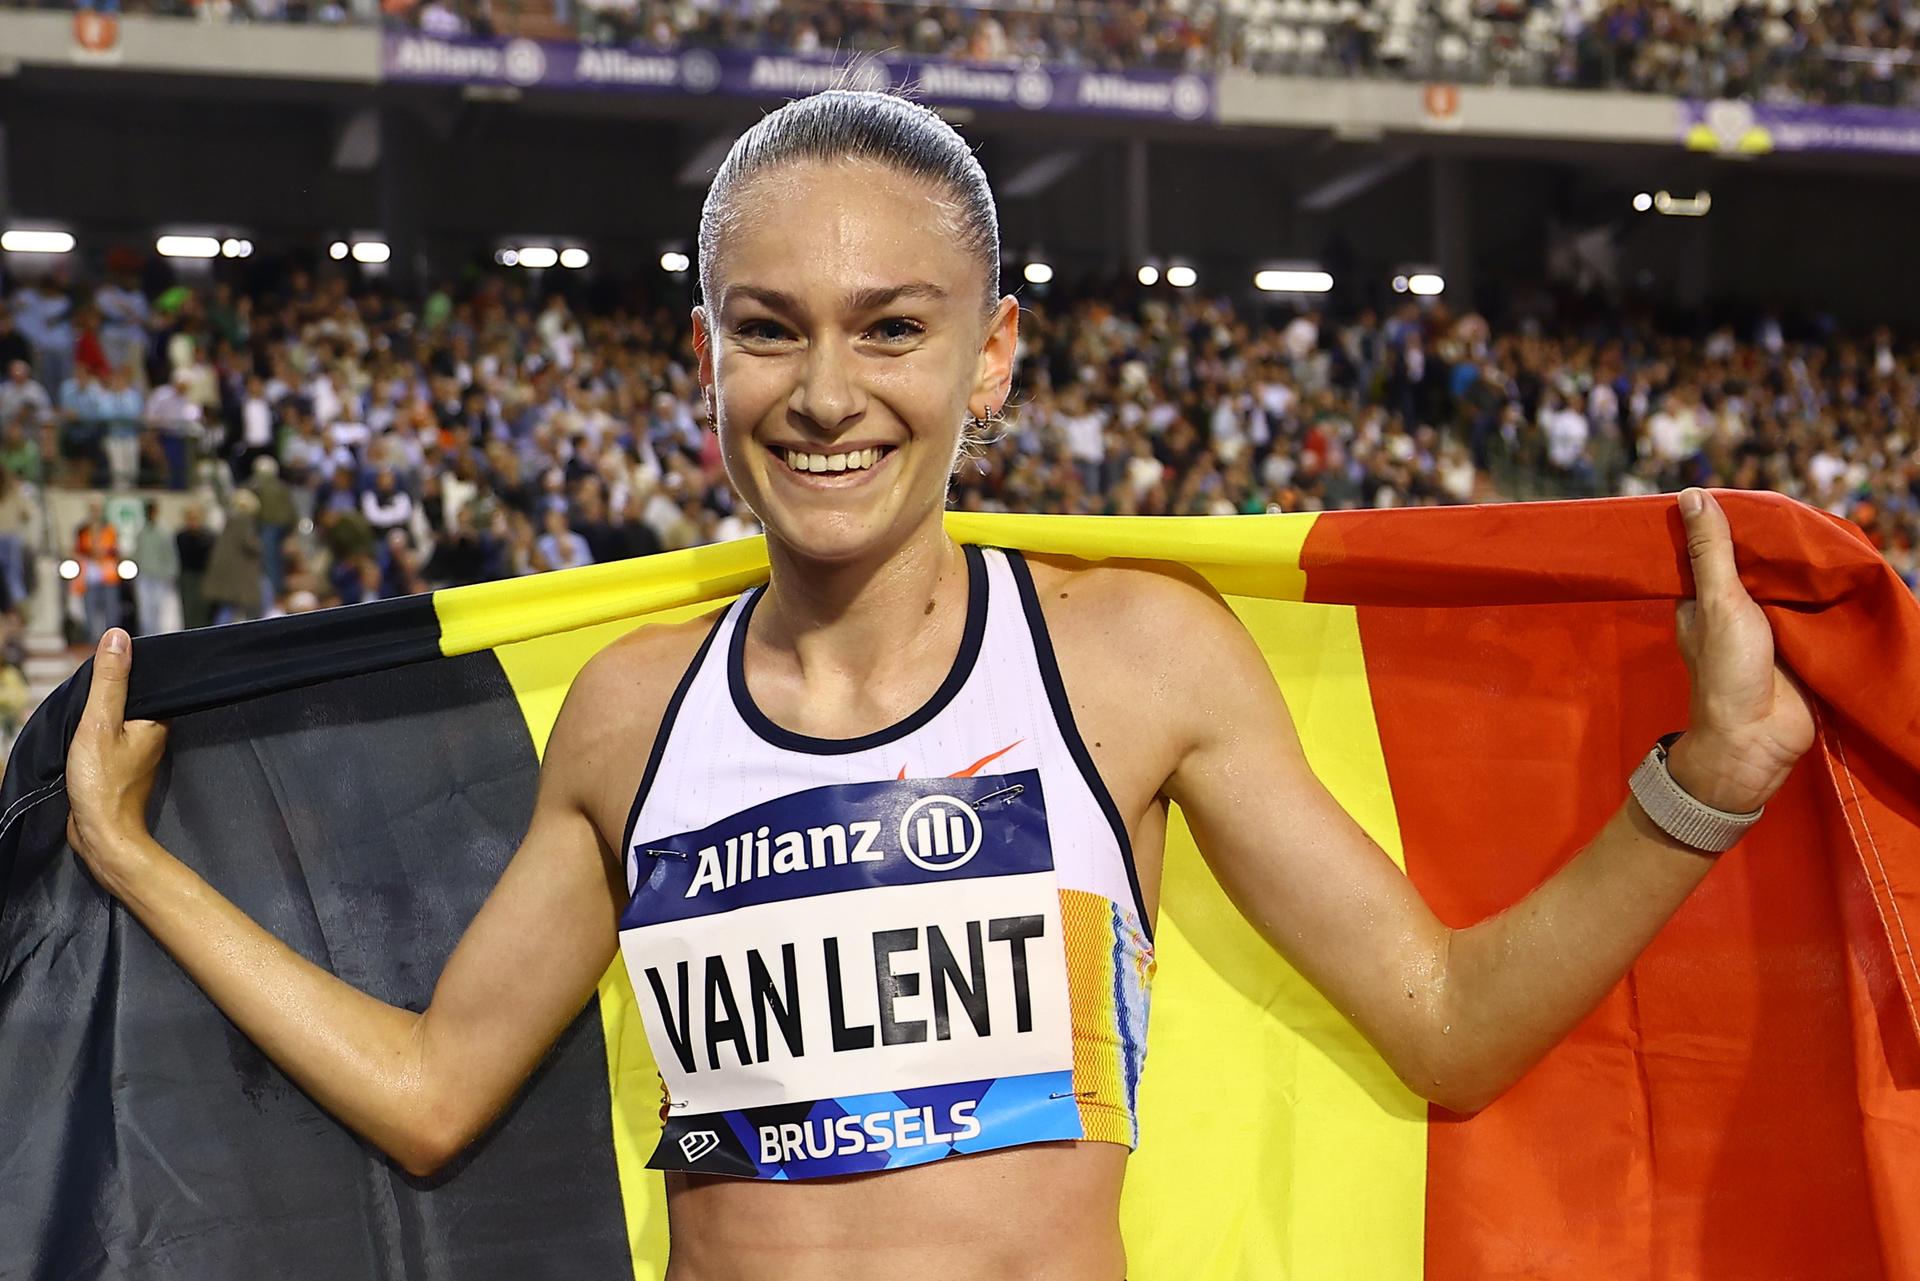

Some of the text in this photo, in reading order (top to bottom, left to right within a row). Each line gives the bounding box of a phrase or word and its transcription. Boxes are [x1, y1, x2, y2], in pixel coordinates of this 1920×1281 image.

[399, 38, 498, 77] Allianz
[575, 49, 678, 85] Allianz
[1077, 73, 1171, 111] Allianz
[685, 820, 884, 899] Allianz
[644, 914, 1045, 1074] VAN LENT
[759, 1099, 981, 1164] BRUSSELS
